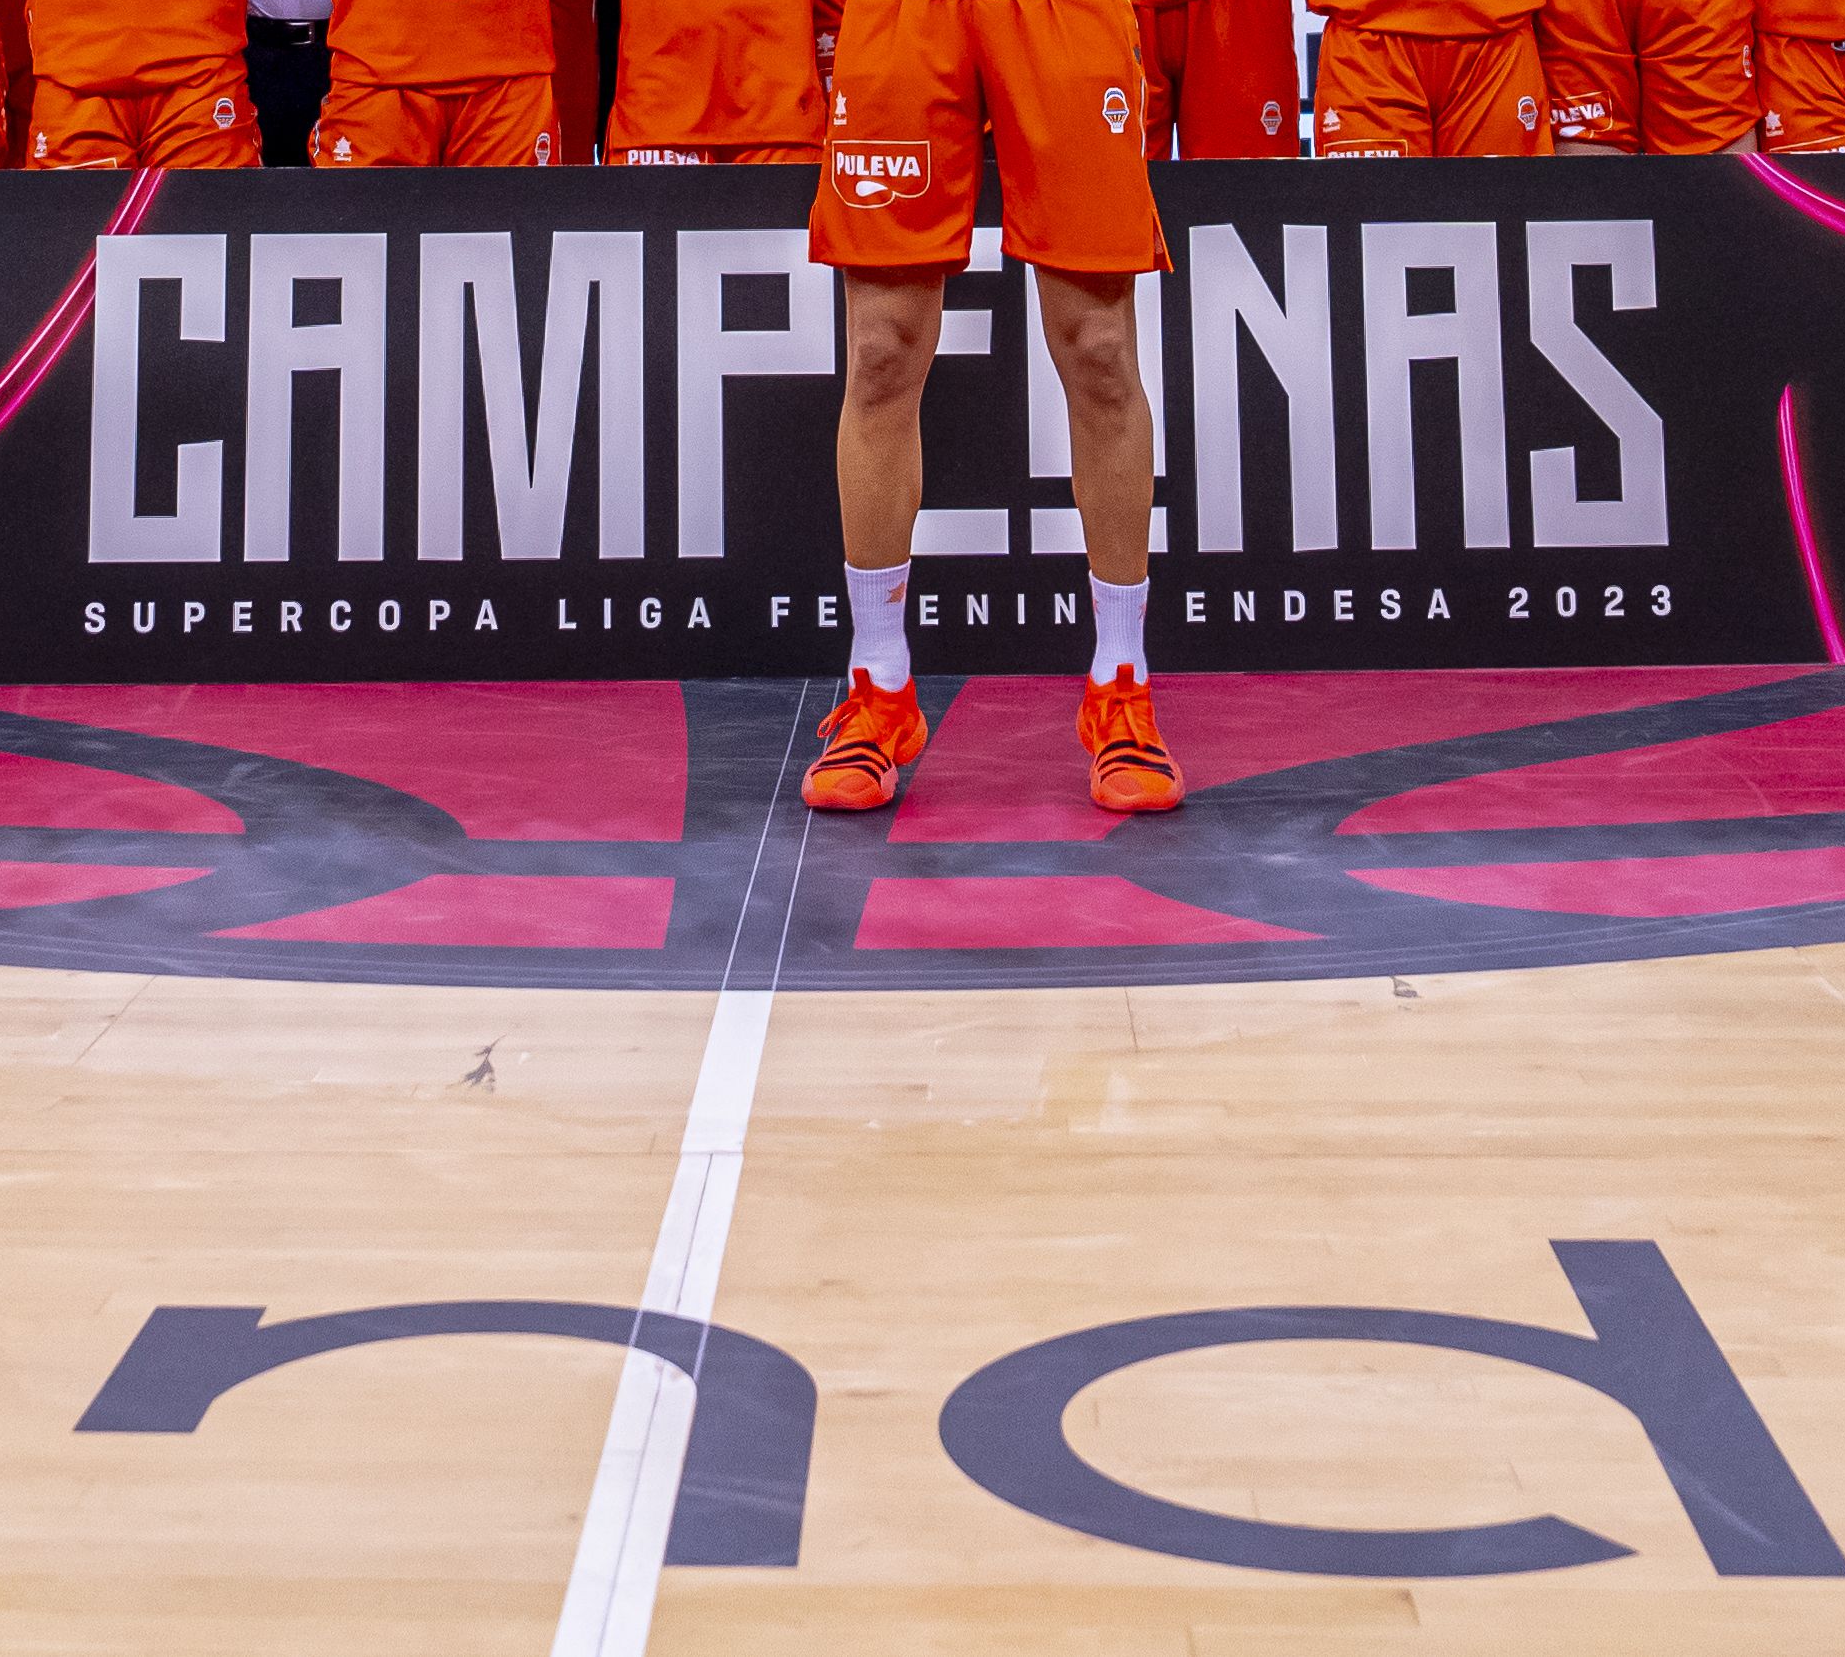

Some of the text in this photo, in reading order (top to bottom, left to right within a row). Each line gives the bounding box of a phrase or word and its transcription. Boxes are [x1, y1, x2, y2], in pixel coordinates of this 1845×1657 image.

[836, 151, 921, 177] PULEVA
[84, 584, 1673, 634] SUPERCOPA LIGA FEENIN ENDESA 2023
